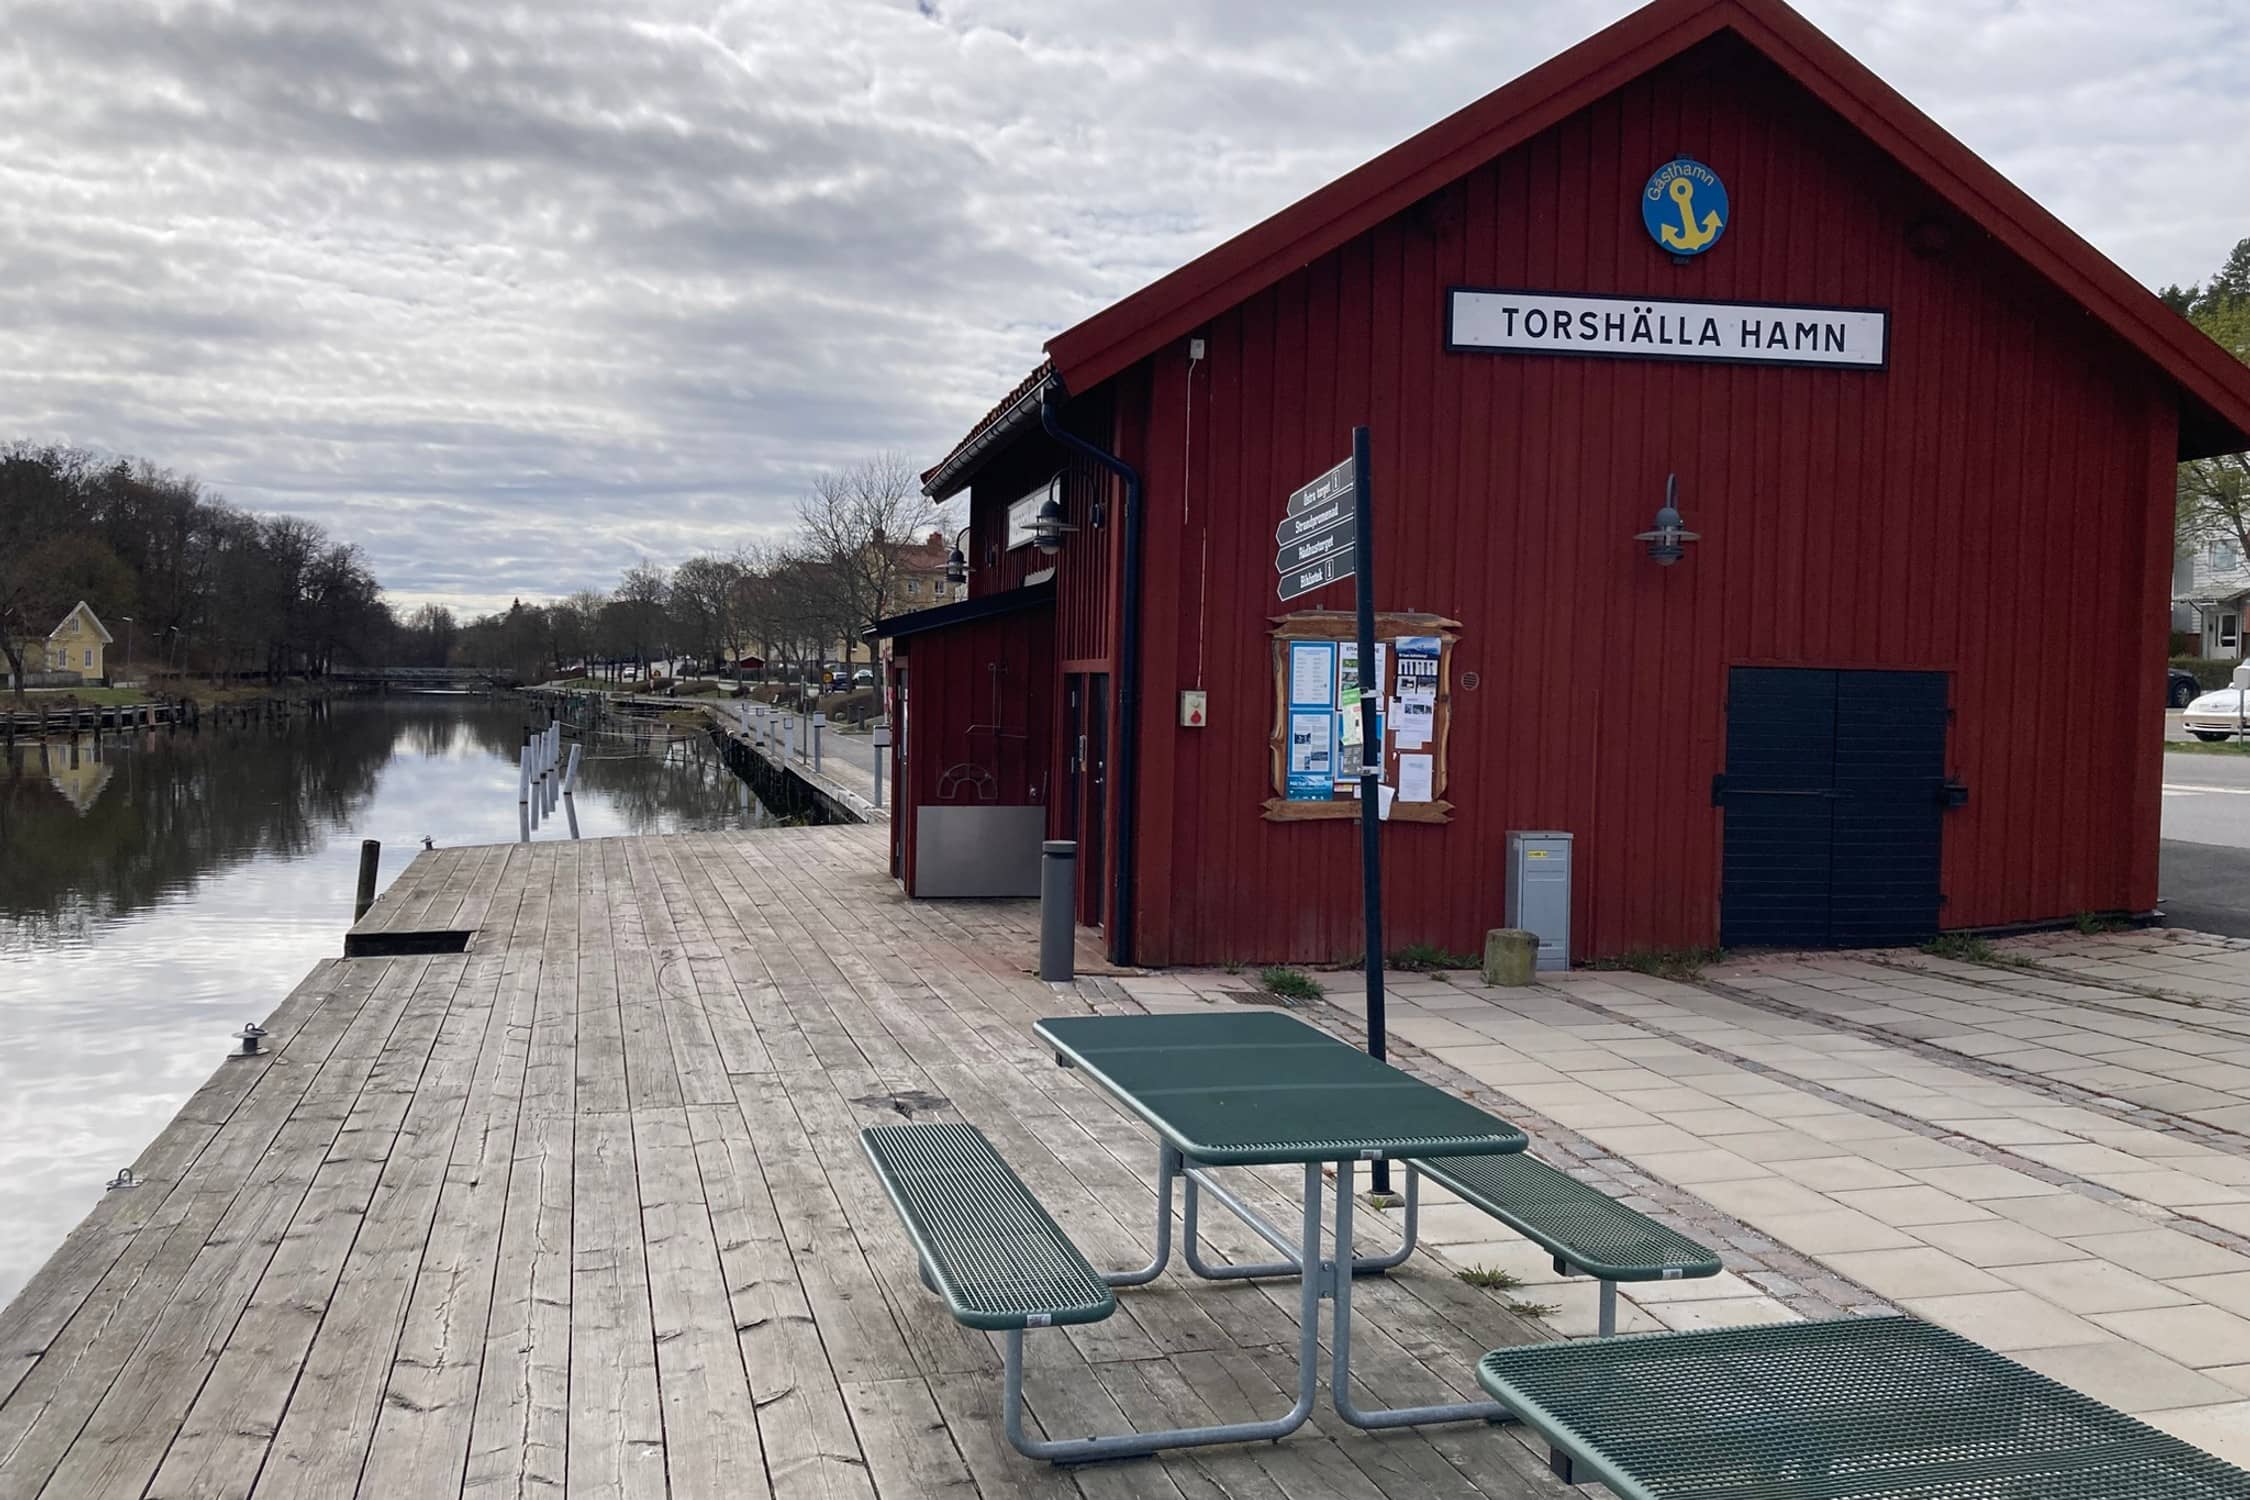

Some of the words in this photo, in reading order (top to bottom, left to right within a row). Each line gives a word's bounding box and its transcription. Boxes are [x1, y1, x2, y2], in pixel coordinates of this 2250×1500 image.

[1647, 162, 1715, 201] Gästhamn
[1501, 305, 1721, 347] TORSHÄLLA
[1740, 319, 1846, 353] HAMN
